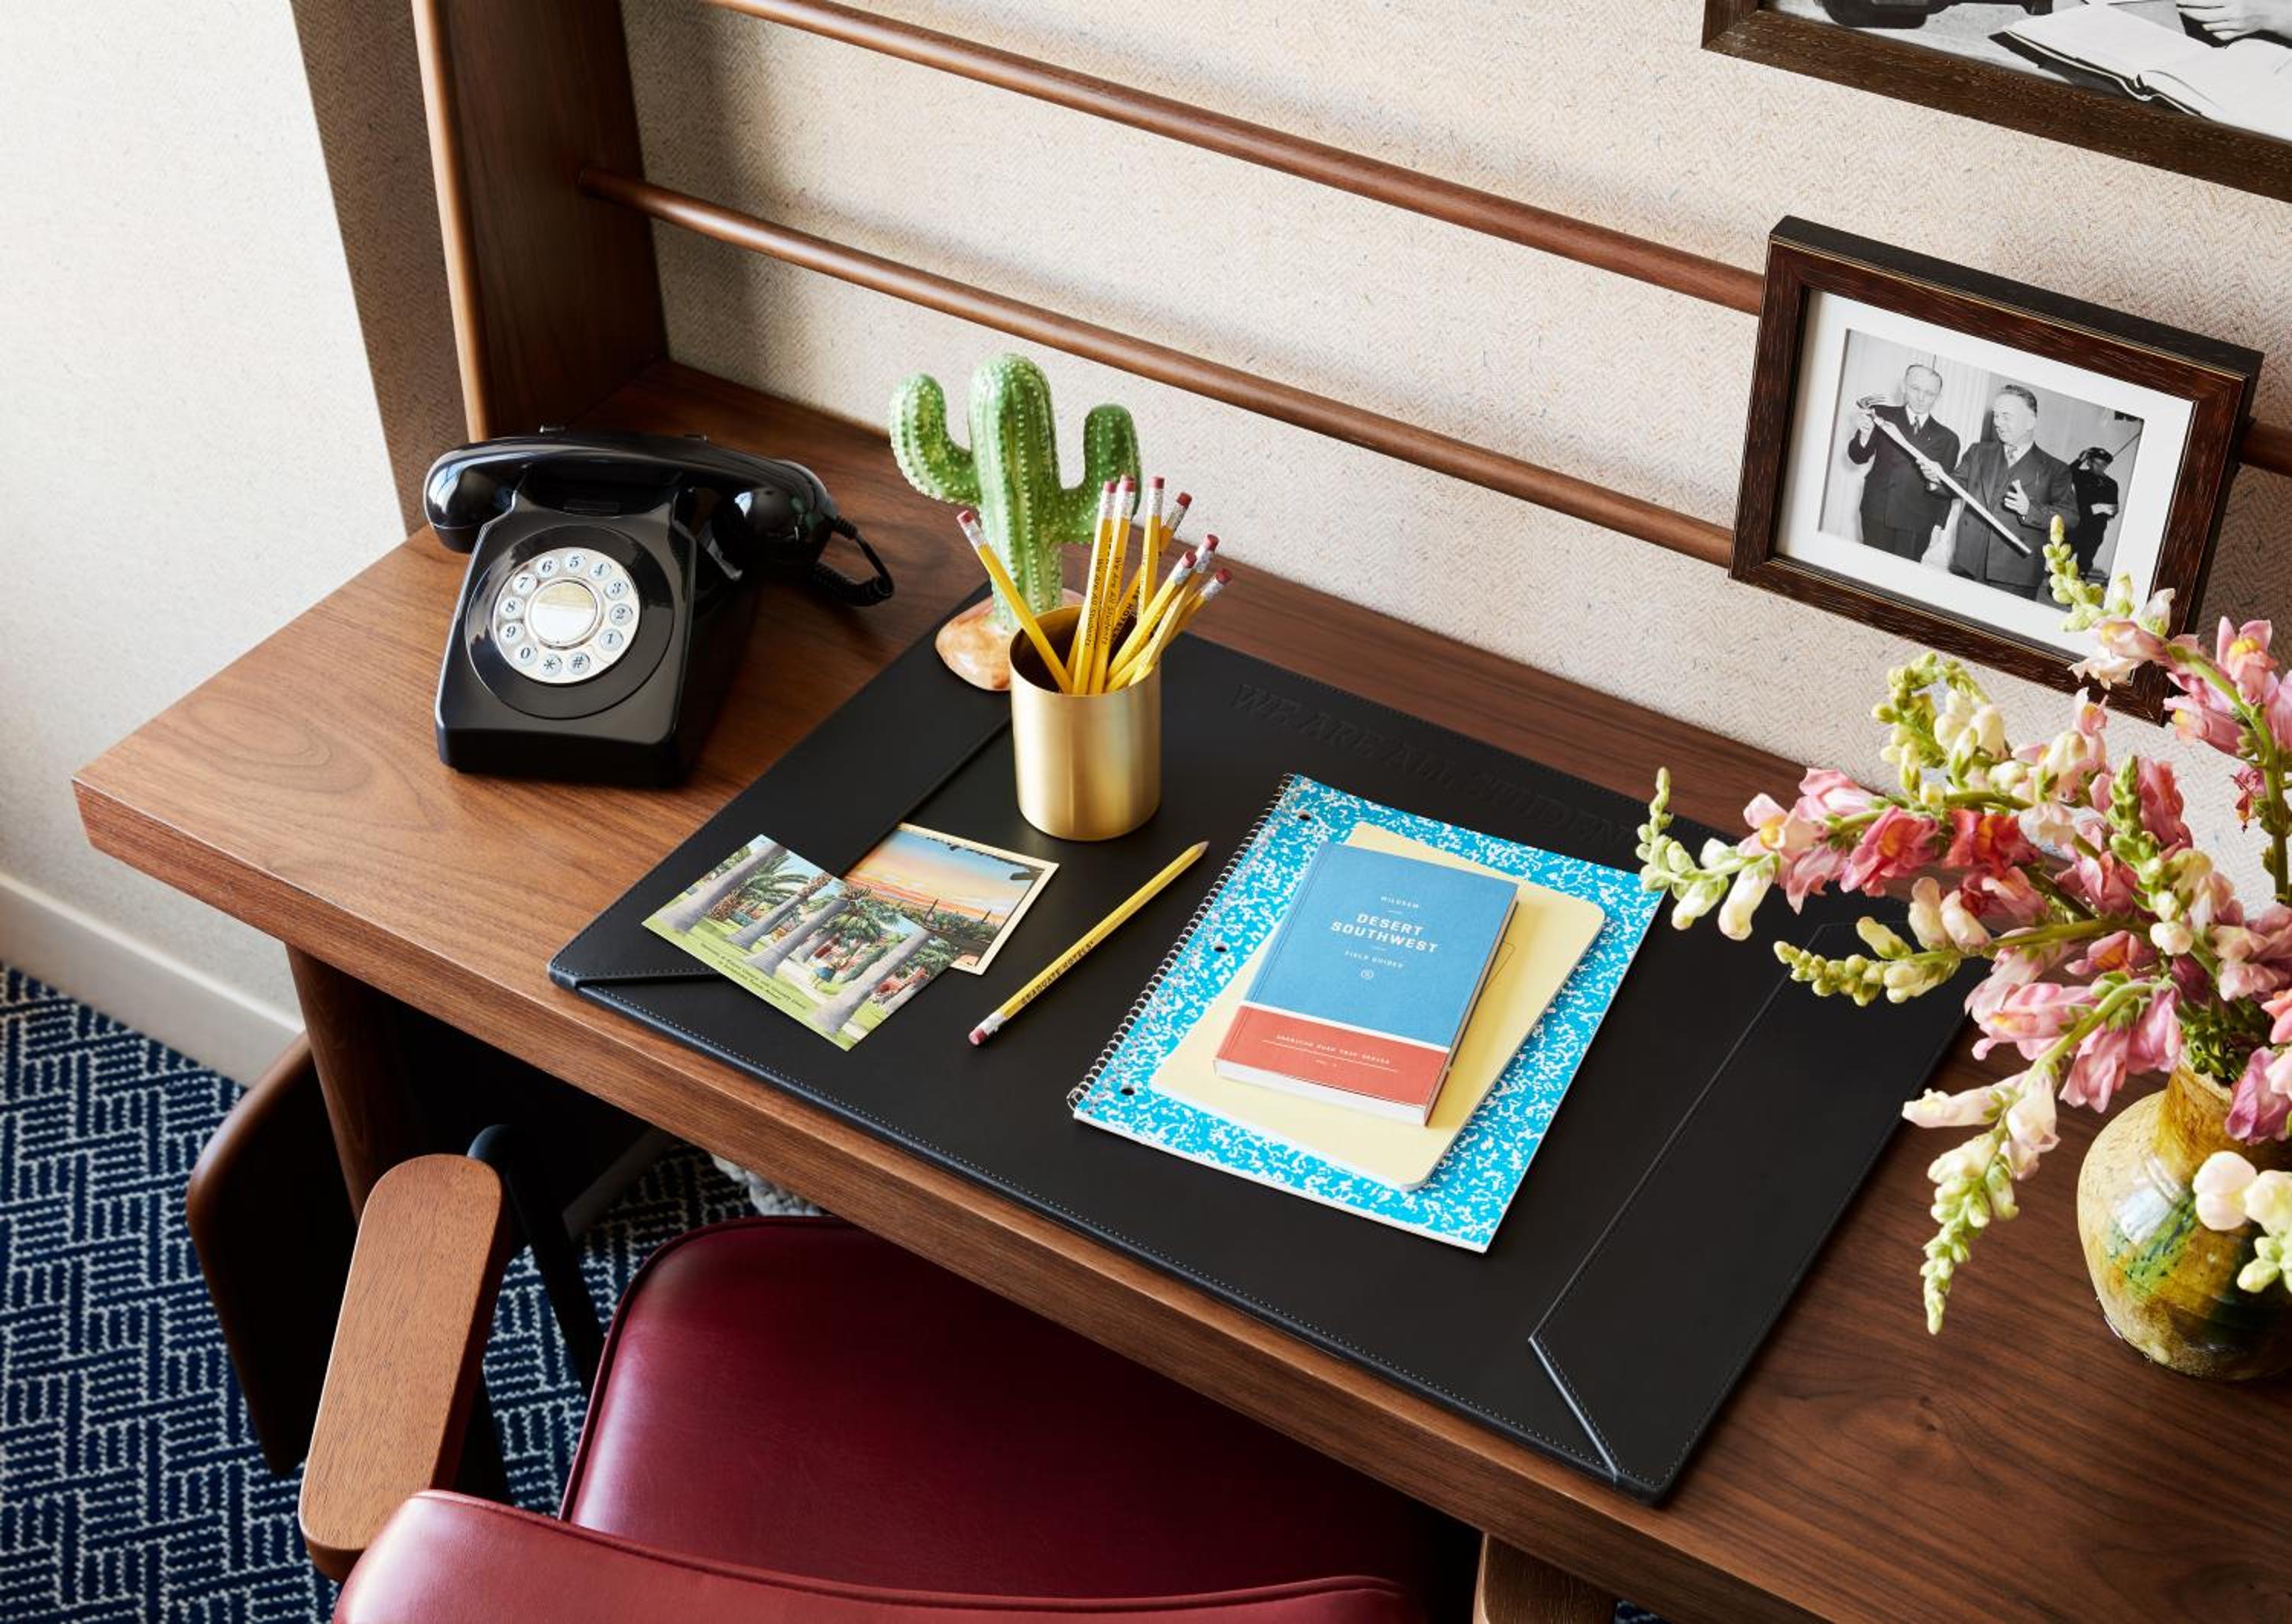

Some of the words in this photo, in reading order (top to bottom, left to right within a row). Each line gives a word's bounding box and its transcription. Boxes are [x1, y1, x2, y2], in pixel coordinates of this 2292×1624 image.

[541, 558, 553, 573] 6
[568, 555, 581, 568] 5
[593, 562, 605, 576] 4
[518, 576, 529, 589] 7
[611, 581, 623, 594] 3
[505, 599, 516, 612] 8
[614, 607, 626, 620] 2
[506, 625, 516, 639] 9
[606, 632, 613, 645] 1
[520, 646, 531, 659] 0
[1355, 912, 1424, 937] DESERT
[1330, 920, 1439, 953] SOUTHWEST
